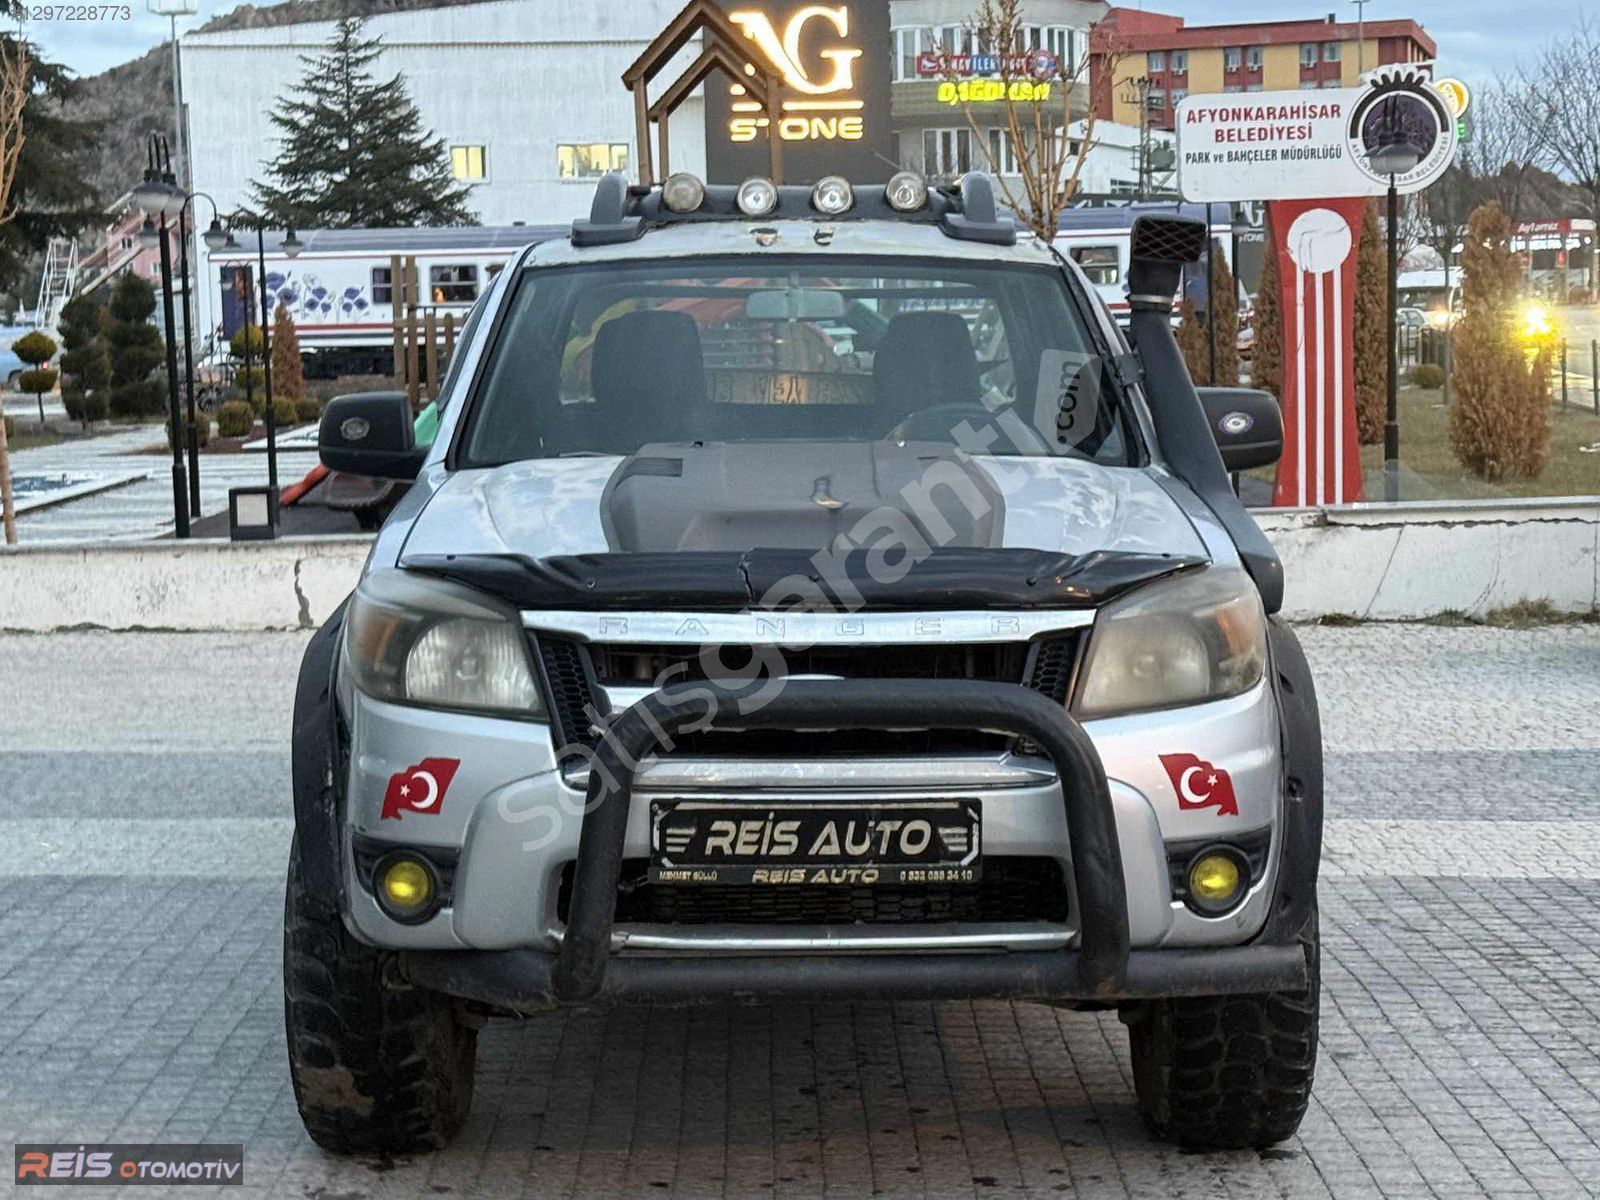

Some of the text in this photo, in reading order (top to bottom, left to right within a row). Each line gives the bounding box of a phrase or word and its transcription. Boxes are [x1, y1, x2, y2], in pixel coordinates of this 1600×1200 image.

[1186, 101, 1342, 124] AFYONKARAHİSAR
[1214, 122, 1313, 143] BELEDİYESİ
[1185, 143, 1342, 165] PARK ve BAHÇELER MÜDÜRLÜĞÜ
[599, 615, 1020, 638] RANGER
[704, 811, 932, 857] REİS AUTO
[809, 868, 880, 885] AUTO
